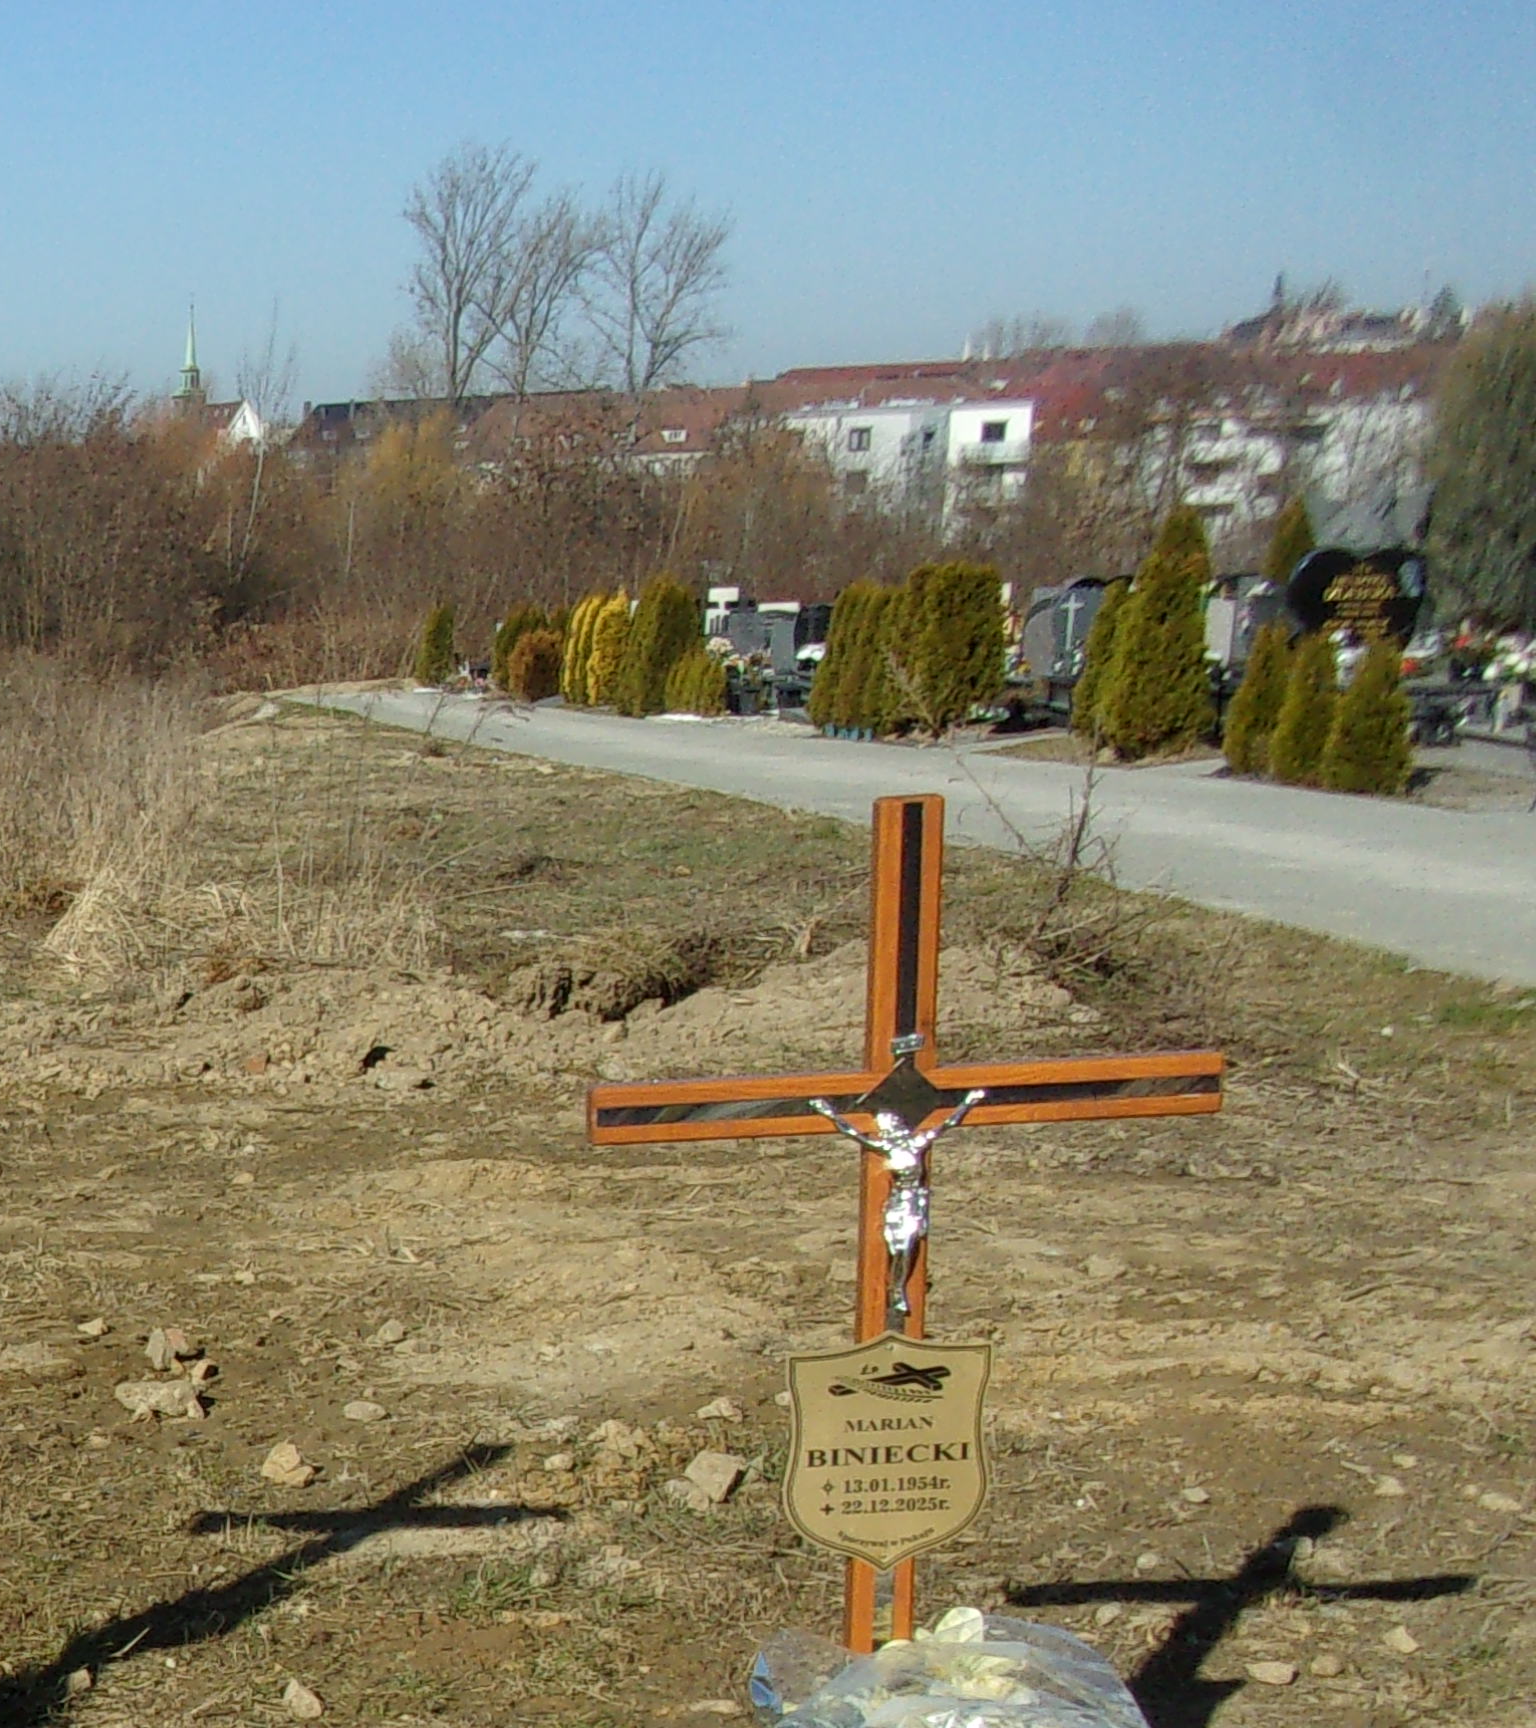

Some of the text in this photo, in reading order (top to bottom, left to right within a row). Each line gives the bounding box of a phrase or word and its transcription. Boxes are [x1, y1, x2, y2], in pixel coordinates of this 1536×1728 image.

[843, 1416, 934, 1433] MARIAN
[806, 1441, 972, 1469] BINIECKI
[842, 1475, 951, 1494] 13.01.1954r.
[840, 1497, 951, 1516] 22.12.2025r.
